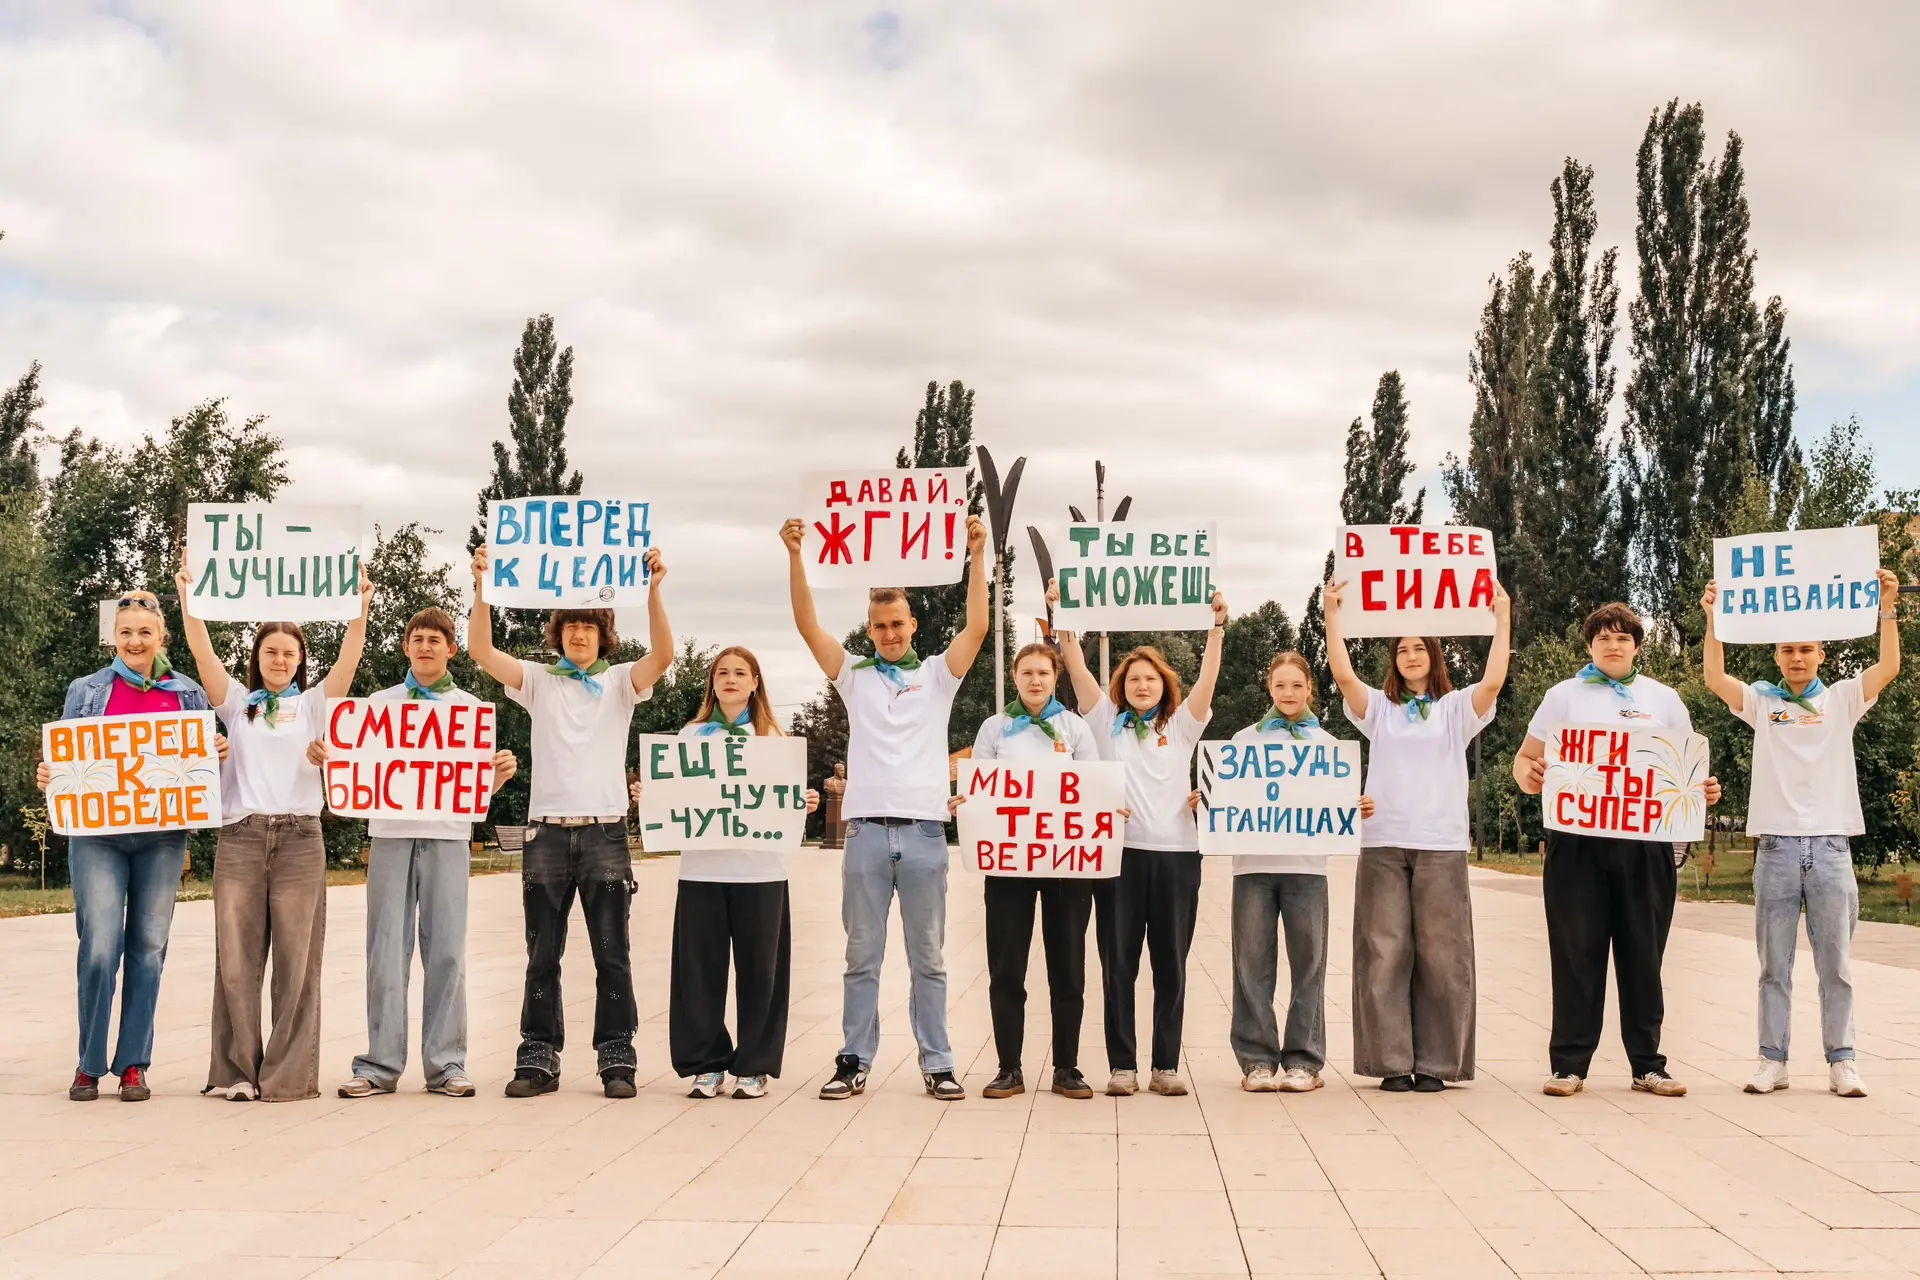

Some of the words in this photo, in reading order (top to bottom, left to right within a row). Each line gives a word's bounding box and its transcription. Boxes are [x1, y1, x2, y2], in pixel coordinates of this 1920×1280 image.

[204, 514, 263, 551] ТЫ
[495, 499, 651, 548] ВПЕРЁД
[813, 511, 956, 565] ЖГИ!
[1069, 527, 1134, 557] ТЫ
[1151, 529, 1211, 556] ВСЁ
[1345, 532, 1365, 558] В
[1390, 526, 1485, 556] ТЕБЕ
[194, 546, 360, 598] ЛУЧШИЙ
[494, 558, 520, 587] К
[539, 553, 650, 597] ЦЕЛИ!
[1731, 545, 1795, 578] НЕ
[1059, 565, 1216, 608] СМОЖЕШЬ
[1361, 568, 1494, 611] СИЛА
[1723, 574, 1880, 614] СДАВАЙСЯ
[49, 719, 207, 762] ВПЕРЕД
[330, 700, 494, 751] СМЕЛЕЕ
[650, 737, 747, 780] ЕЩЁ
[1218, 744, 1351, 780] ЗАБУДЬ
[1561, 729, 1629, 765] ЖГИ
[117, 753, 145, 795] К
[327, 760, 493, 814] БЫСТРЕЕ
[969, 767, 1034, 798] МЫ
[1060, 772, 1080, 804] В
[1598, 766, 1654, 798] ТЫ
[54, 785, 209, 829] ПОБЕДЕ
[721, 784, 807, 810] ЧУТЬ
[1556, 792, 1663, 834] СУПЕР
[997, 806, 1113, 839] ТЕБЯ
[1210, 806, 1357, 836] ГРАНИЦАХ
[977, 841, 1103, 871] ВЕРИМ
